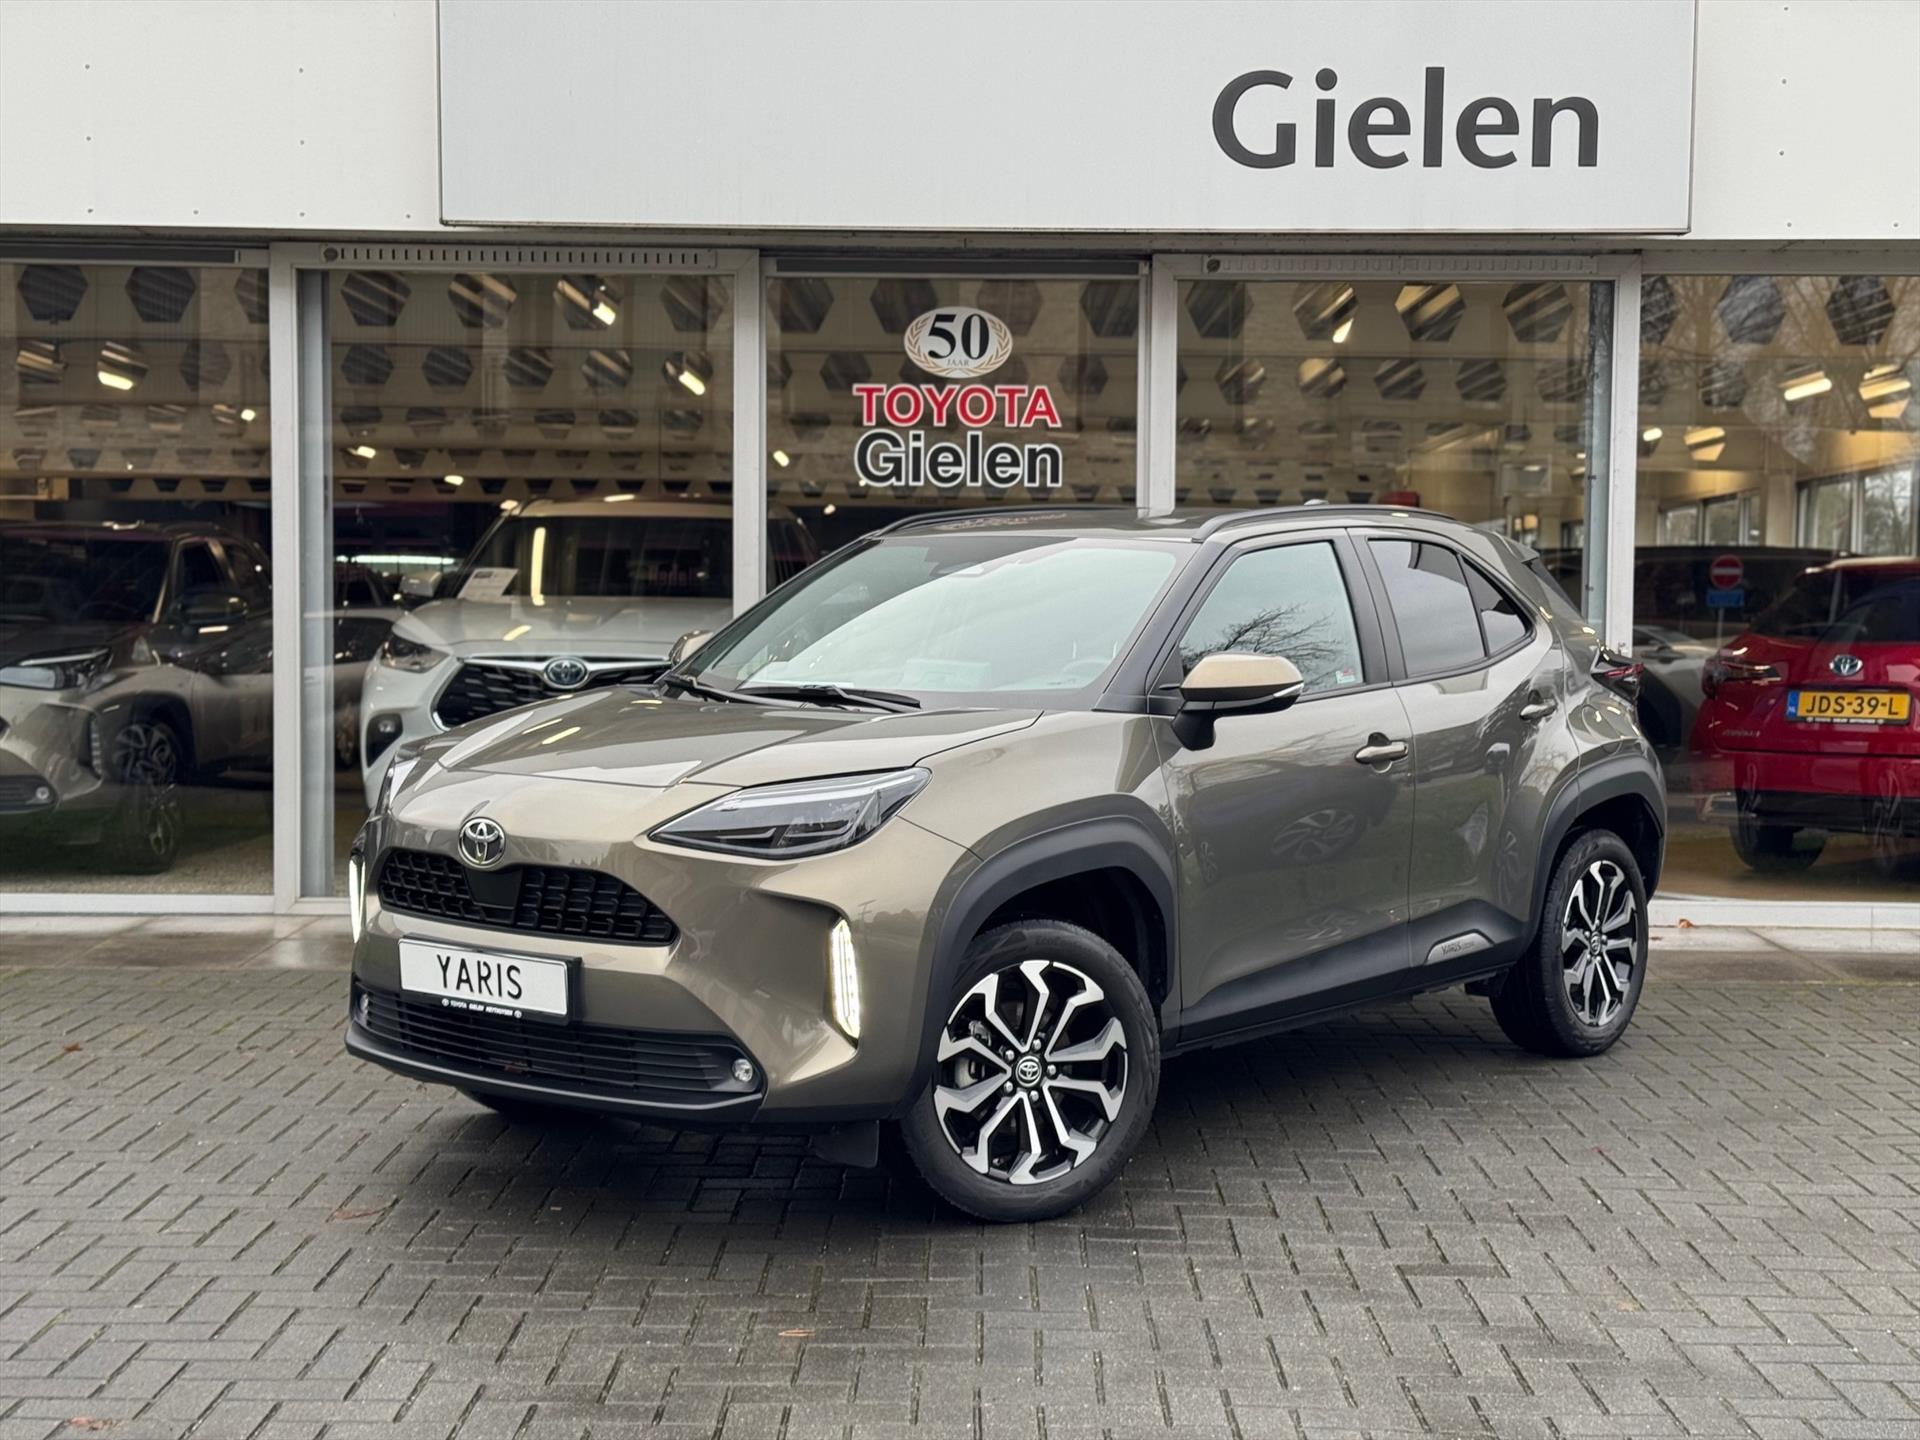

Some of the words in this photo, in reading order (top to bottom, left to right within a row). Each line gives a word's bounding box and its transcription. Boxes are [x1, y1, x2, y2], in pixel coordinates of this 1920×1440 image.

[1212, 66, 1599, 169] Gielen
[927, 313, 990, 360] 50
[946, 359, 970, 367] JAAR
[853, 383, 1062, 427] TOYOTA
[854, 428, 1063, 488] Gielen
[1805, 695, 1900, 715] JDS-39-L
[436, 954, 523, 1000] YARIS
